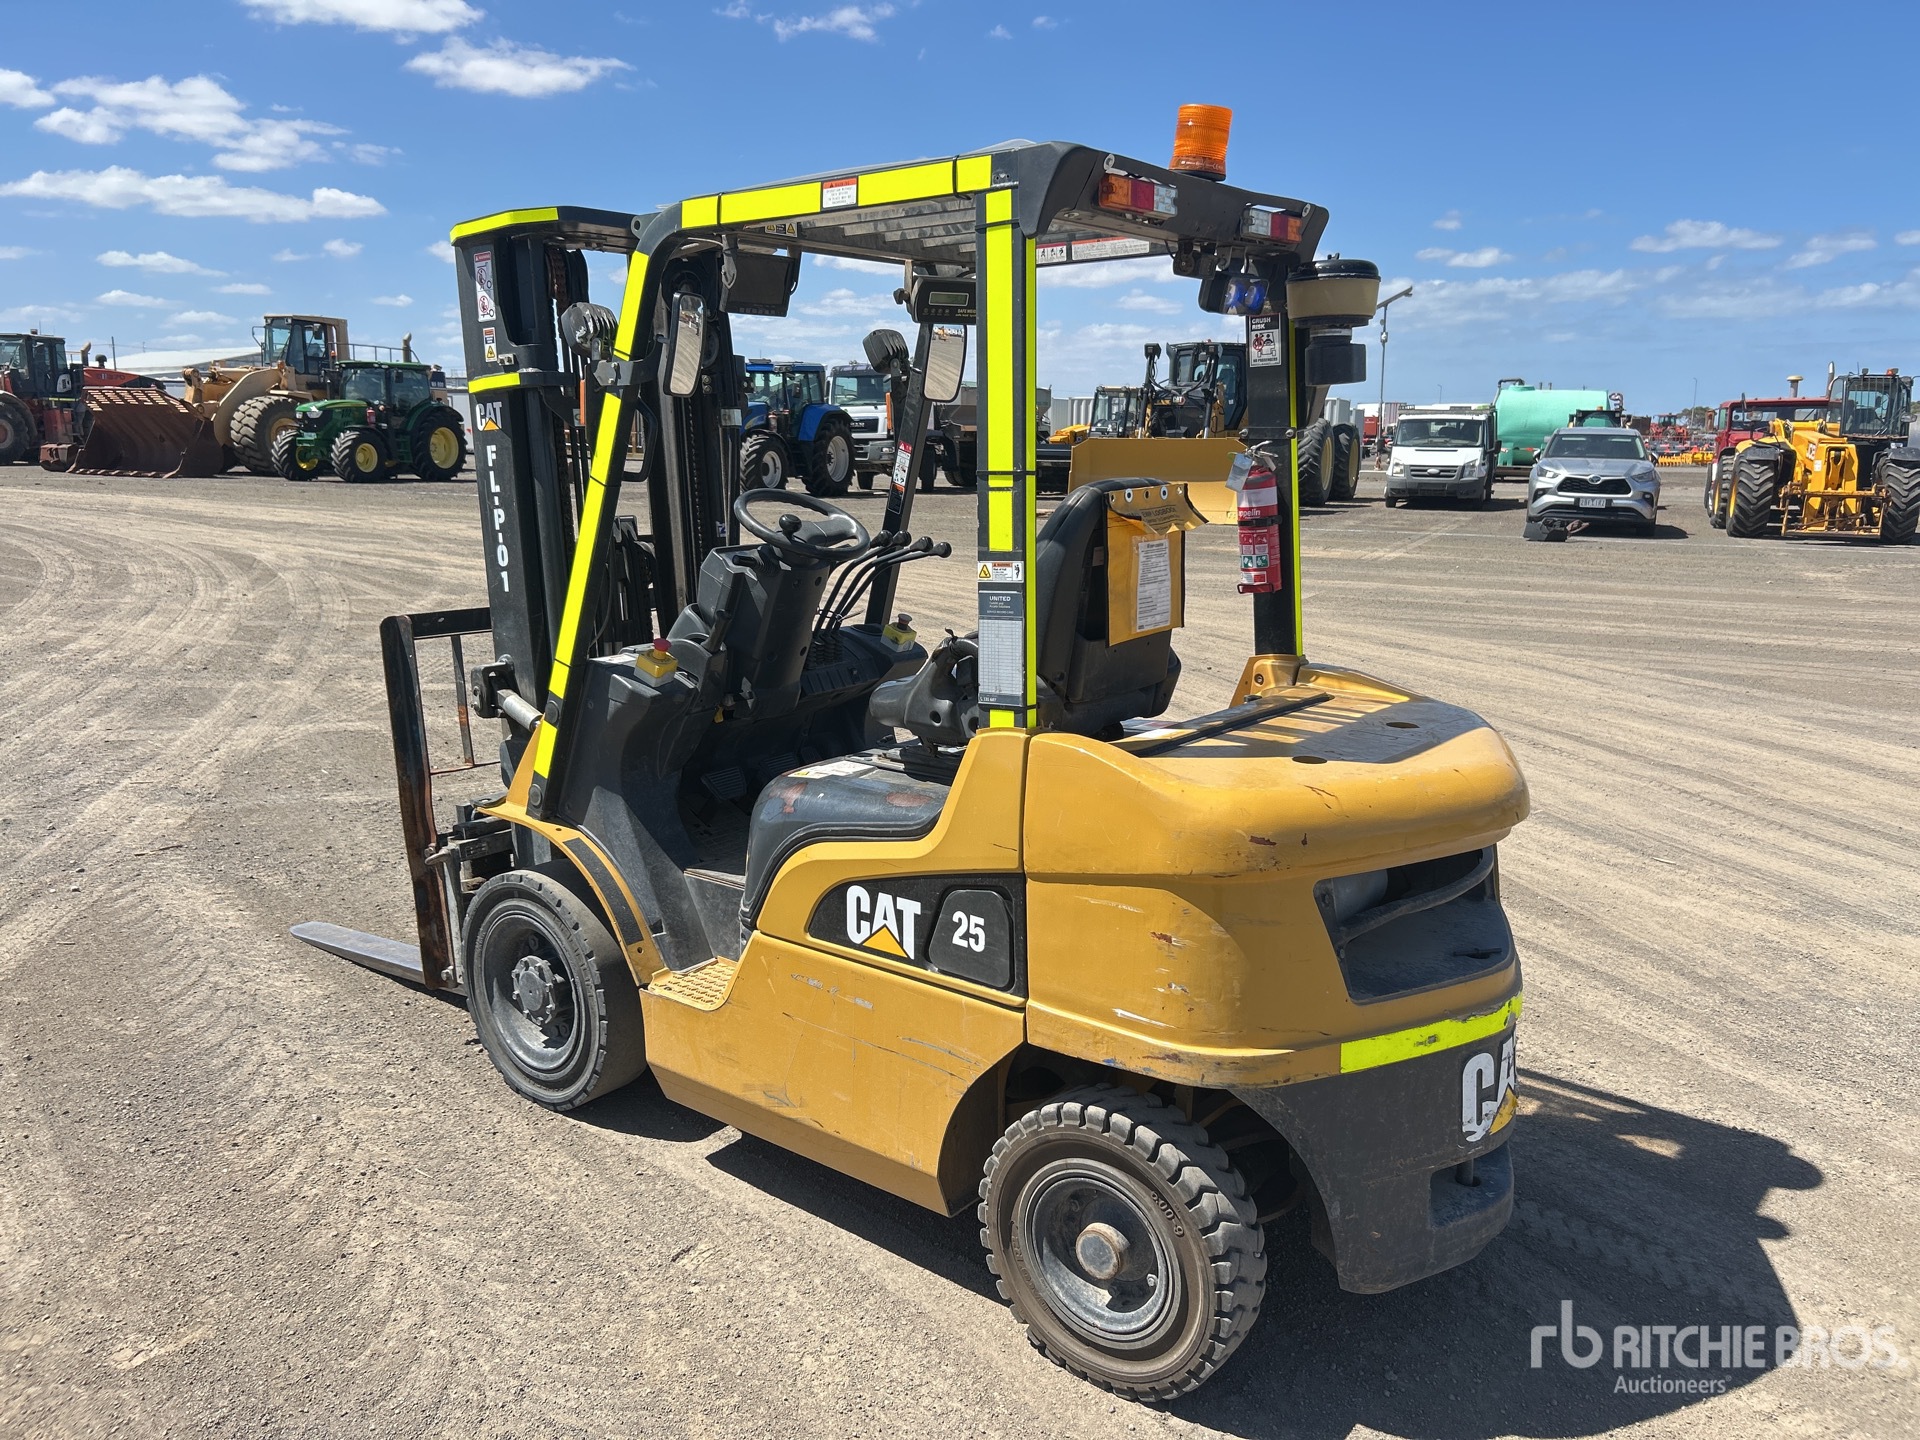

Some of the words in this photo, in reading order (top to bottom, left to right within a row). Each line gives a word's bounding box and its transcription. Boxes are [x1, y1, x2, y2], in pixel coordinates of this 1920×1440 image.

[476, 401, 503, 431] CAT
[846, 885, 921, 960] CAT
[952, 911, 986, 952] 25
[1462, 1031, 1517, 1142] CA
